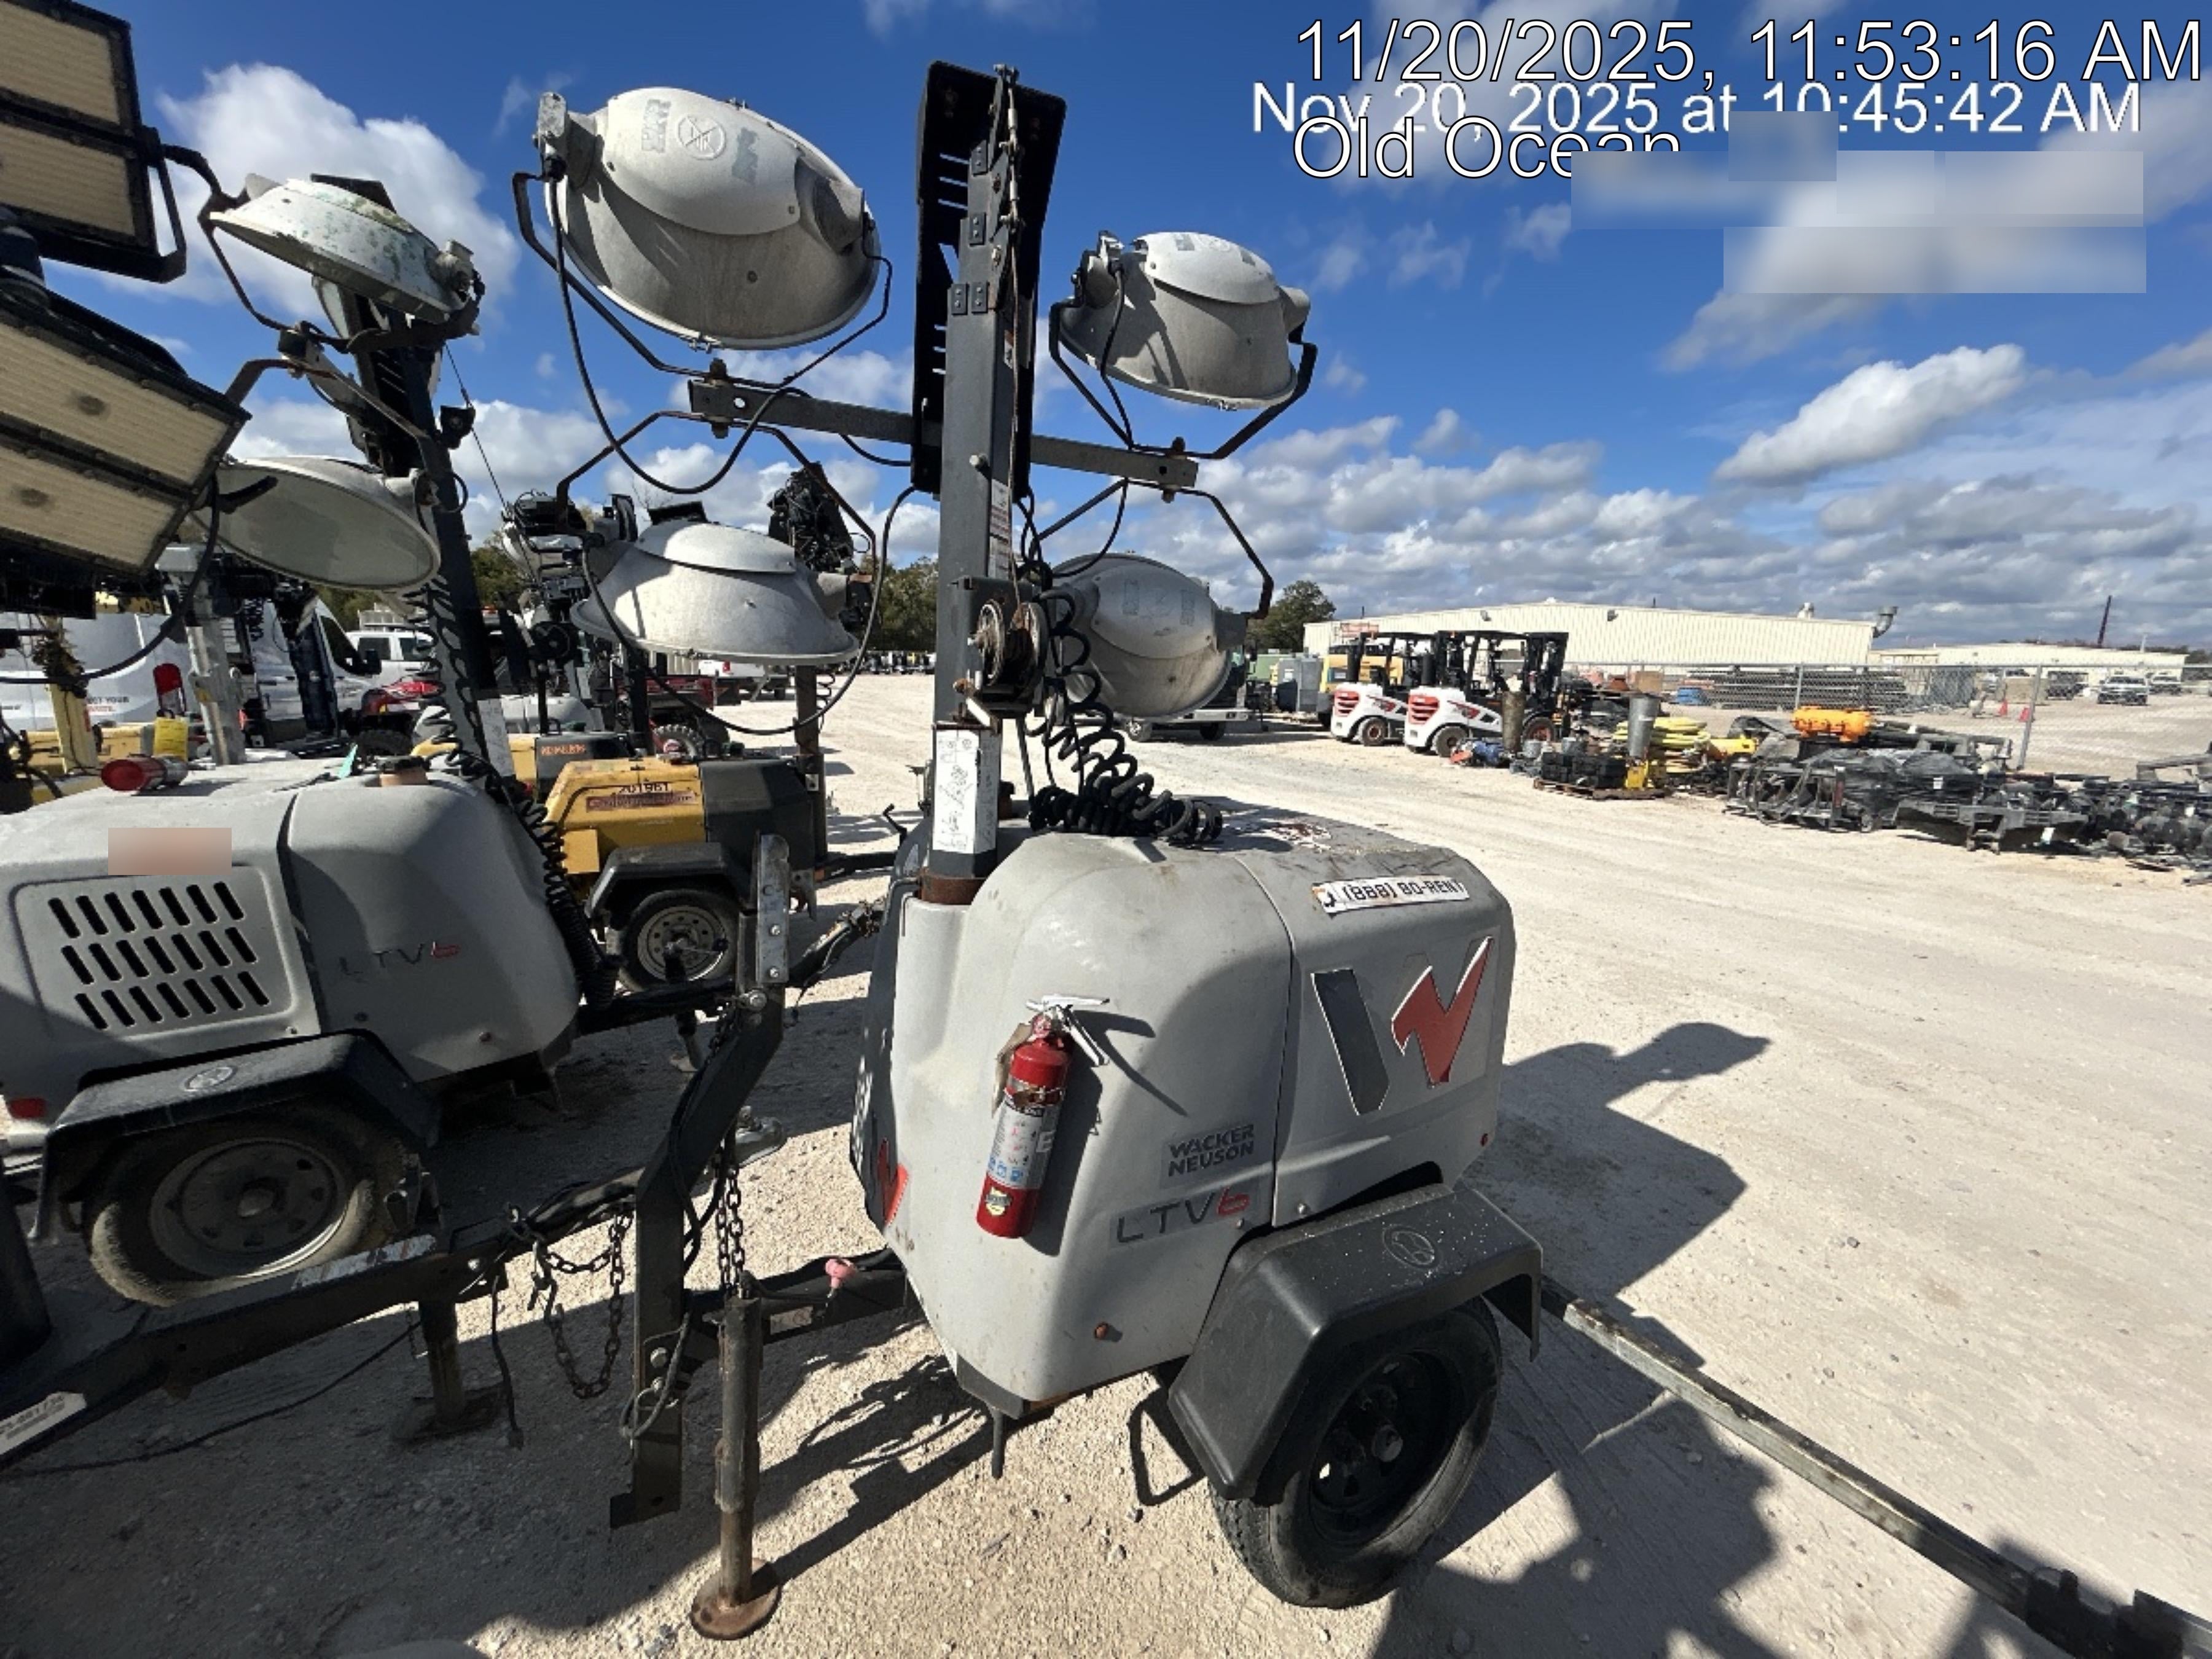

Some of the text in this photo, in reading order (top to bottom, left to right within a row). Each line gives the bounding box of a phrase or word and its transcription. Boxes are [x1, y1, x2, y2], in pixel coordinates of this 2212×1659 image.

[1169, 1124, 1254, 1158] WACKER
[1169, 1140, 1254, 1177] NEUSON
[1116, 1186, 1250, 1243] LTV6
